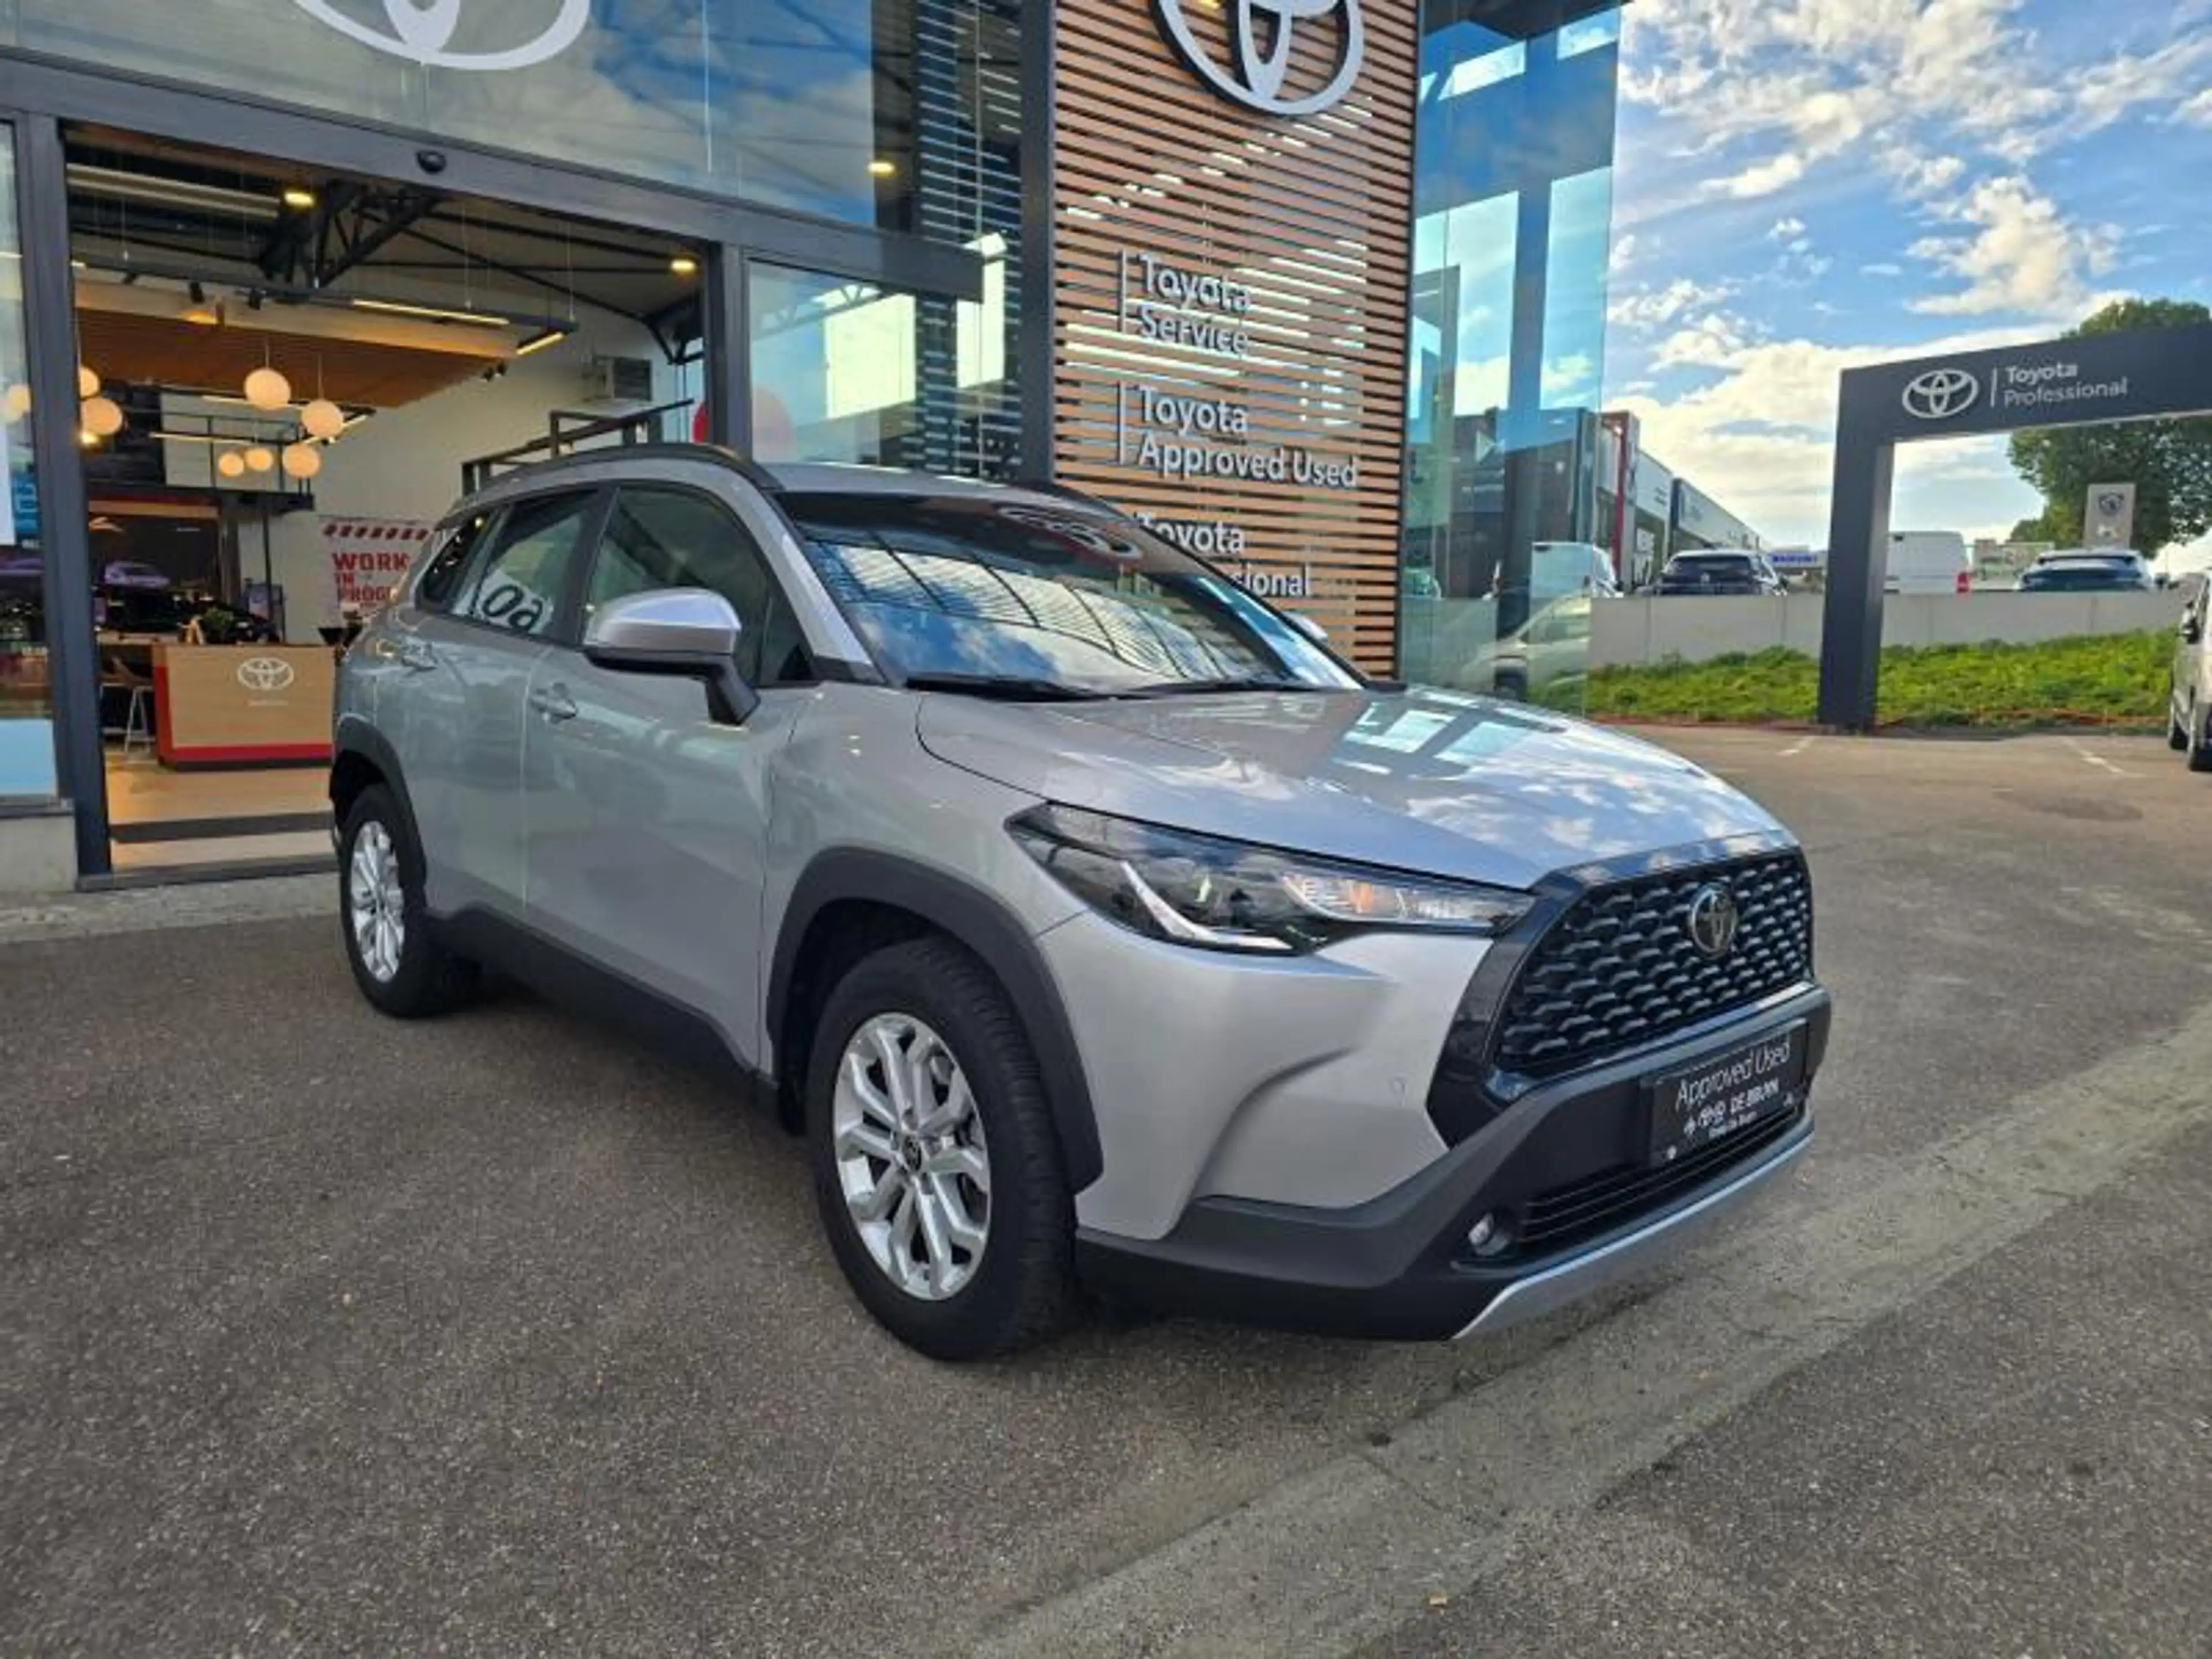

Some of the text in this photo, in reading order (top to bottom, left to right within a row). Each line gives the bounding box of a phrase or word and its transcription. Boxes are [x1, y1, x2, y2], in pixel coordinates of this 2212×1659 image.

[1139, 253, 1251, 312] Toyota
[1139, 304, 1249, 353] Service
[2004, 376, 2128, 408] Professional
[2005, 362, 2078, 386] Toyota
[1141, 387, 1249, 436] Toyota
[1139, 431, 1358, 487] Approved Used
[331, 552, 410, 570] WORK
[1675, 1035, 1791, 1113] Approved Used
